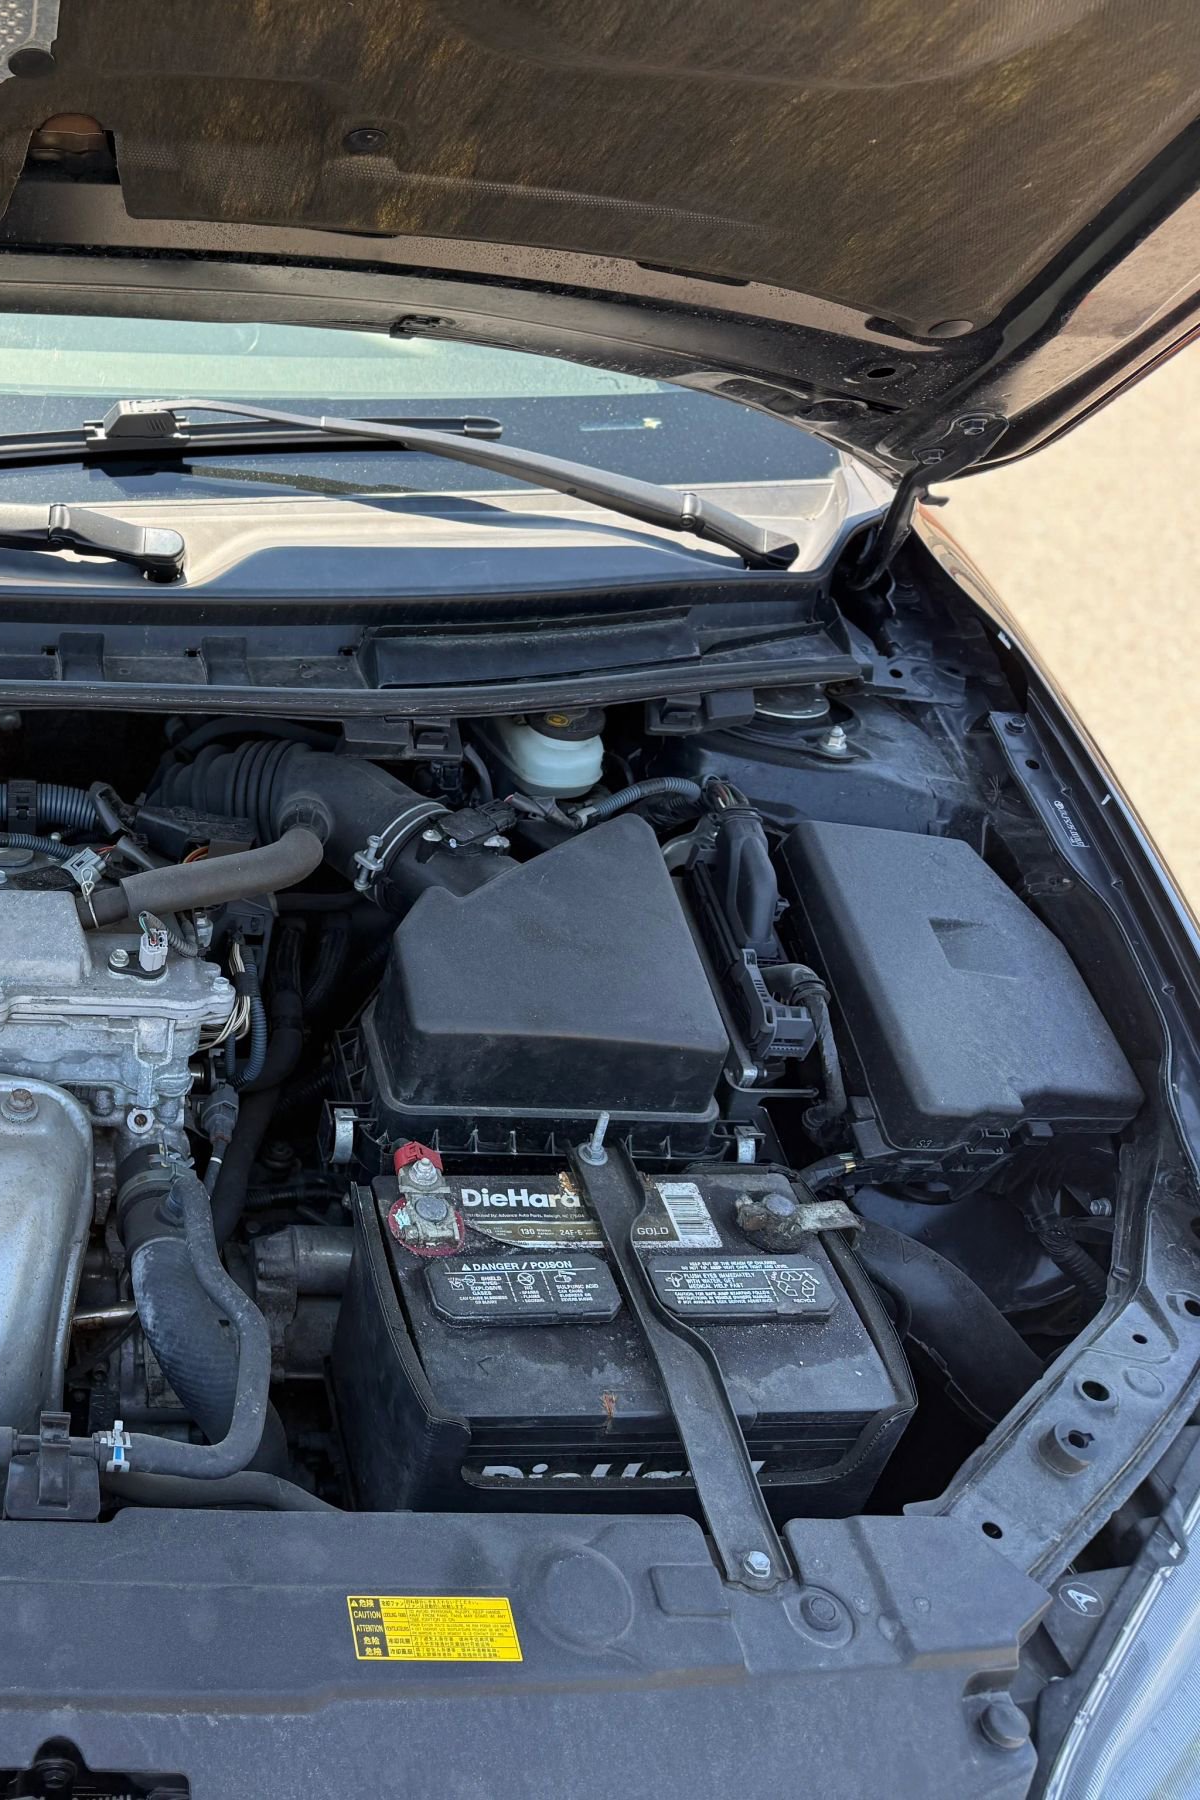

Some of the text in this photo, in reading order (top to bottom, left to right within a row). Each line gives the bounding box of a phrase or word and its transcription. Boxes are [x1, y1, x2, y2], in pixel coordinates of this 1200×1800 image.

[637, 1227, 669, 1235] GOLD
[472, 1262, 519, 1271] DANGER
[530, 1260, 572, 1270] POISON
[1067, 1589, 1098, 1612] A
[353, 1610, 381, 1619] CAUTION
[356, 1624, 384, 1632] ATTENTION
